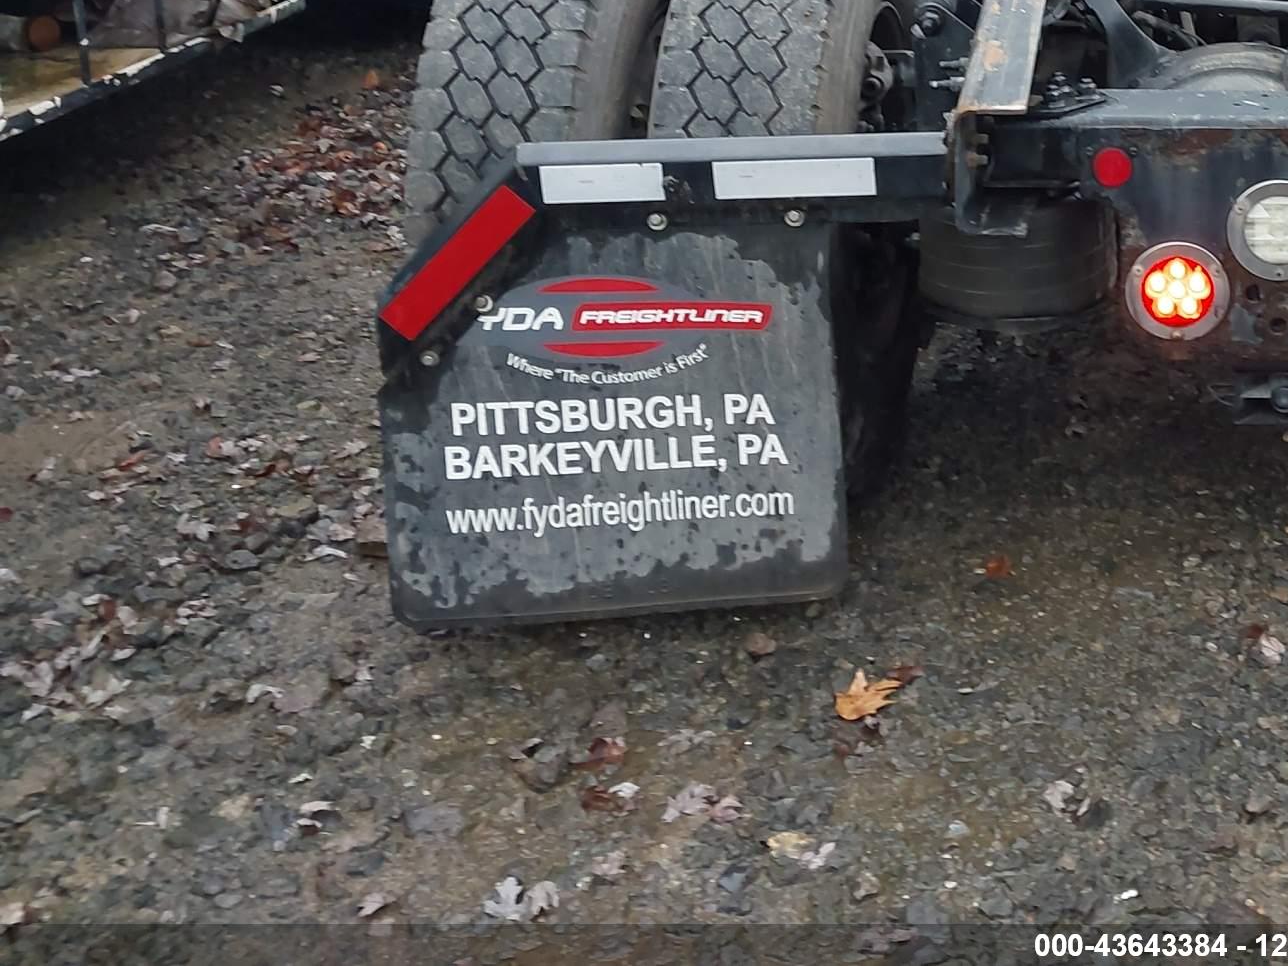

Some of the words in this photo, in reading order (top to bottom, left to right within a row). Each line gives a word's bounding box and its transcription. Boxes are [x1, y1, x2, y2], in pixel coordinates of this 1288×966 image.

[476, 306, 564, 331] YDA
[579, 308, 764, 324] FREIGHTLINER
[506, 352, 554, 380] Where
[591, 366, 663, 385] Customer
[664, 361, 678, 375] is
[450, 394, 713, 436] PITTSBURGH,
[723, 393, 776, 425] PA
[444, 434, 727, 480] BARKEYVILLE,
[738, 434, 790, 465] PA
[446, 490, 794, 538] www.fydafreightliner.com
